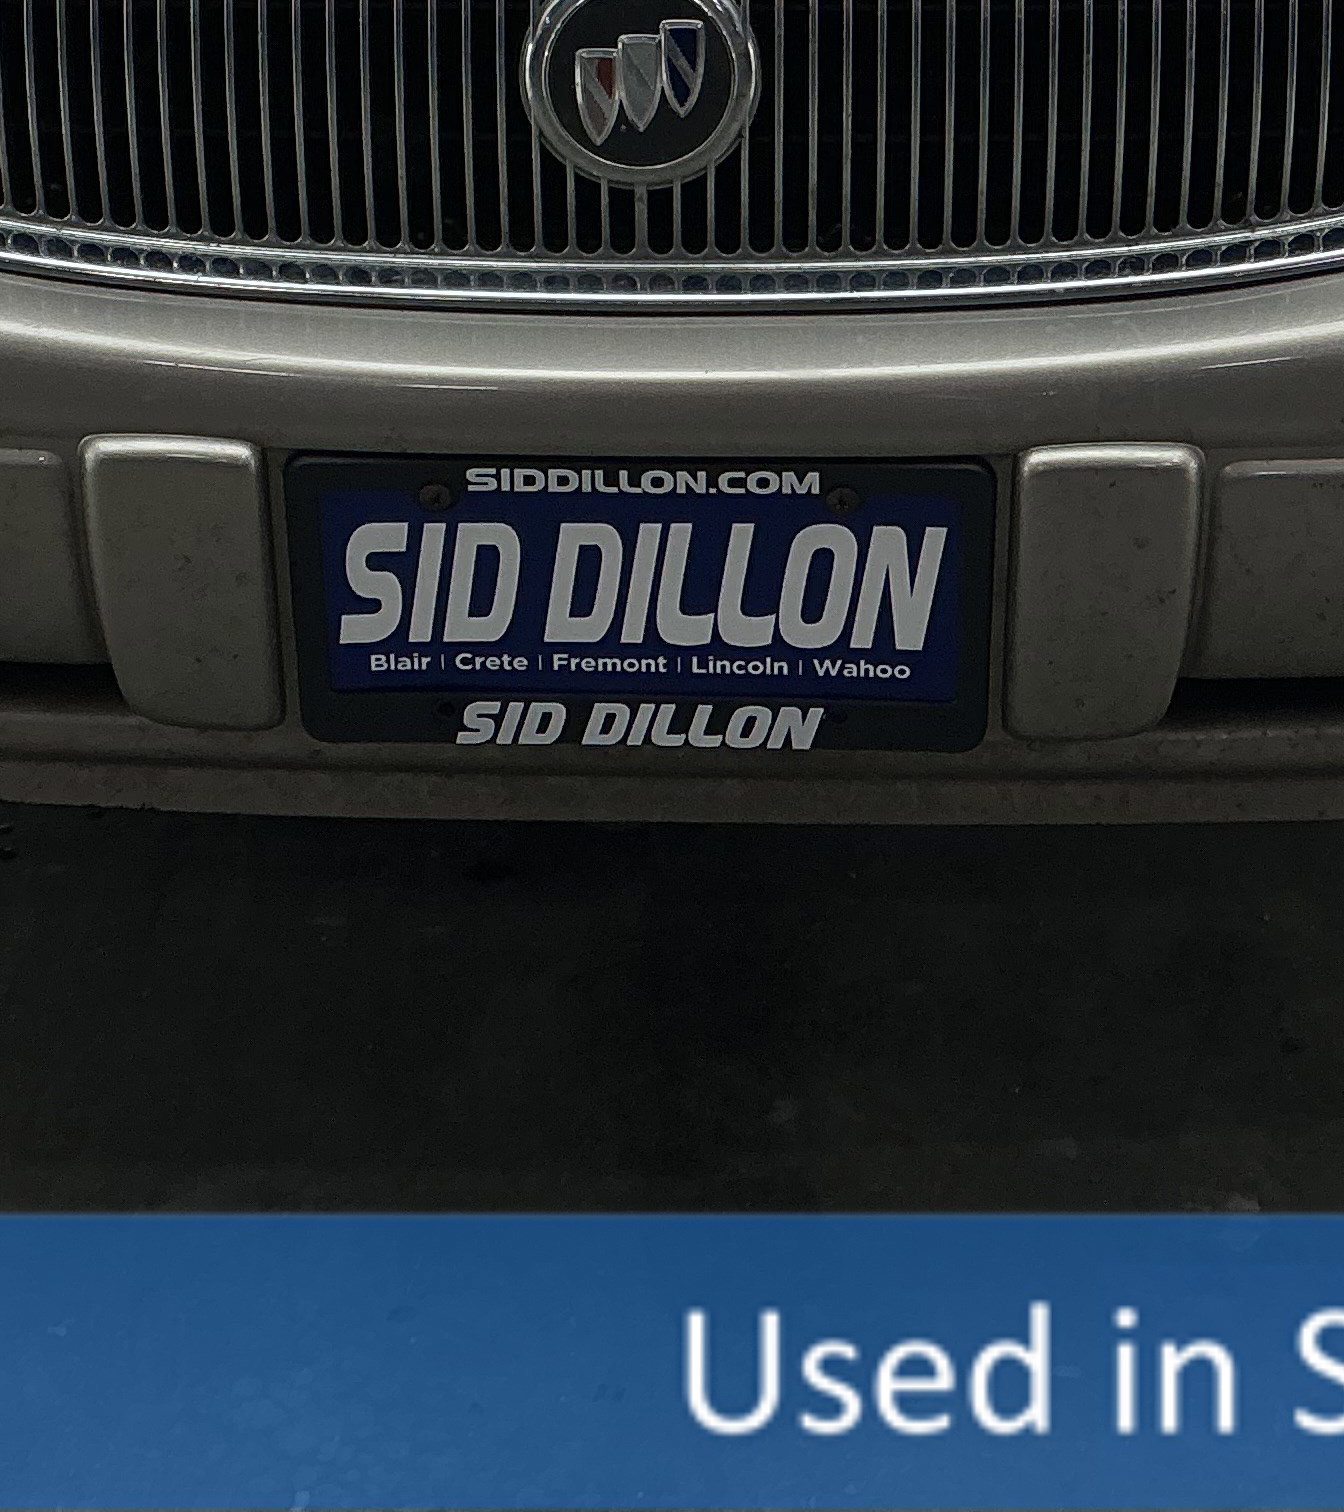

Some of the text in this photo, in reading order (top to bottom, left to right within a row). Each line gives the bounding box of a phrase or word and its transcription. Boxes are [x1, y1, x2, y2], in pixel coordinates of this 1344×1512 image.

[465, 467, 821, 496] SIDDILLON.COM
[338, 521, 949, 651] SID DILLON
[369, 651, 912, 680] Blair Crete Fremont Lincoln Wahoo
[455, 700, 826, 751] SID DILLON
